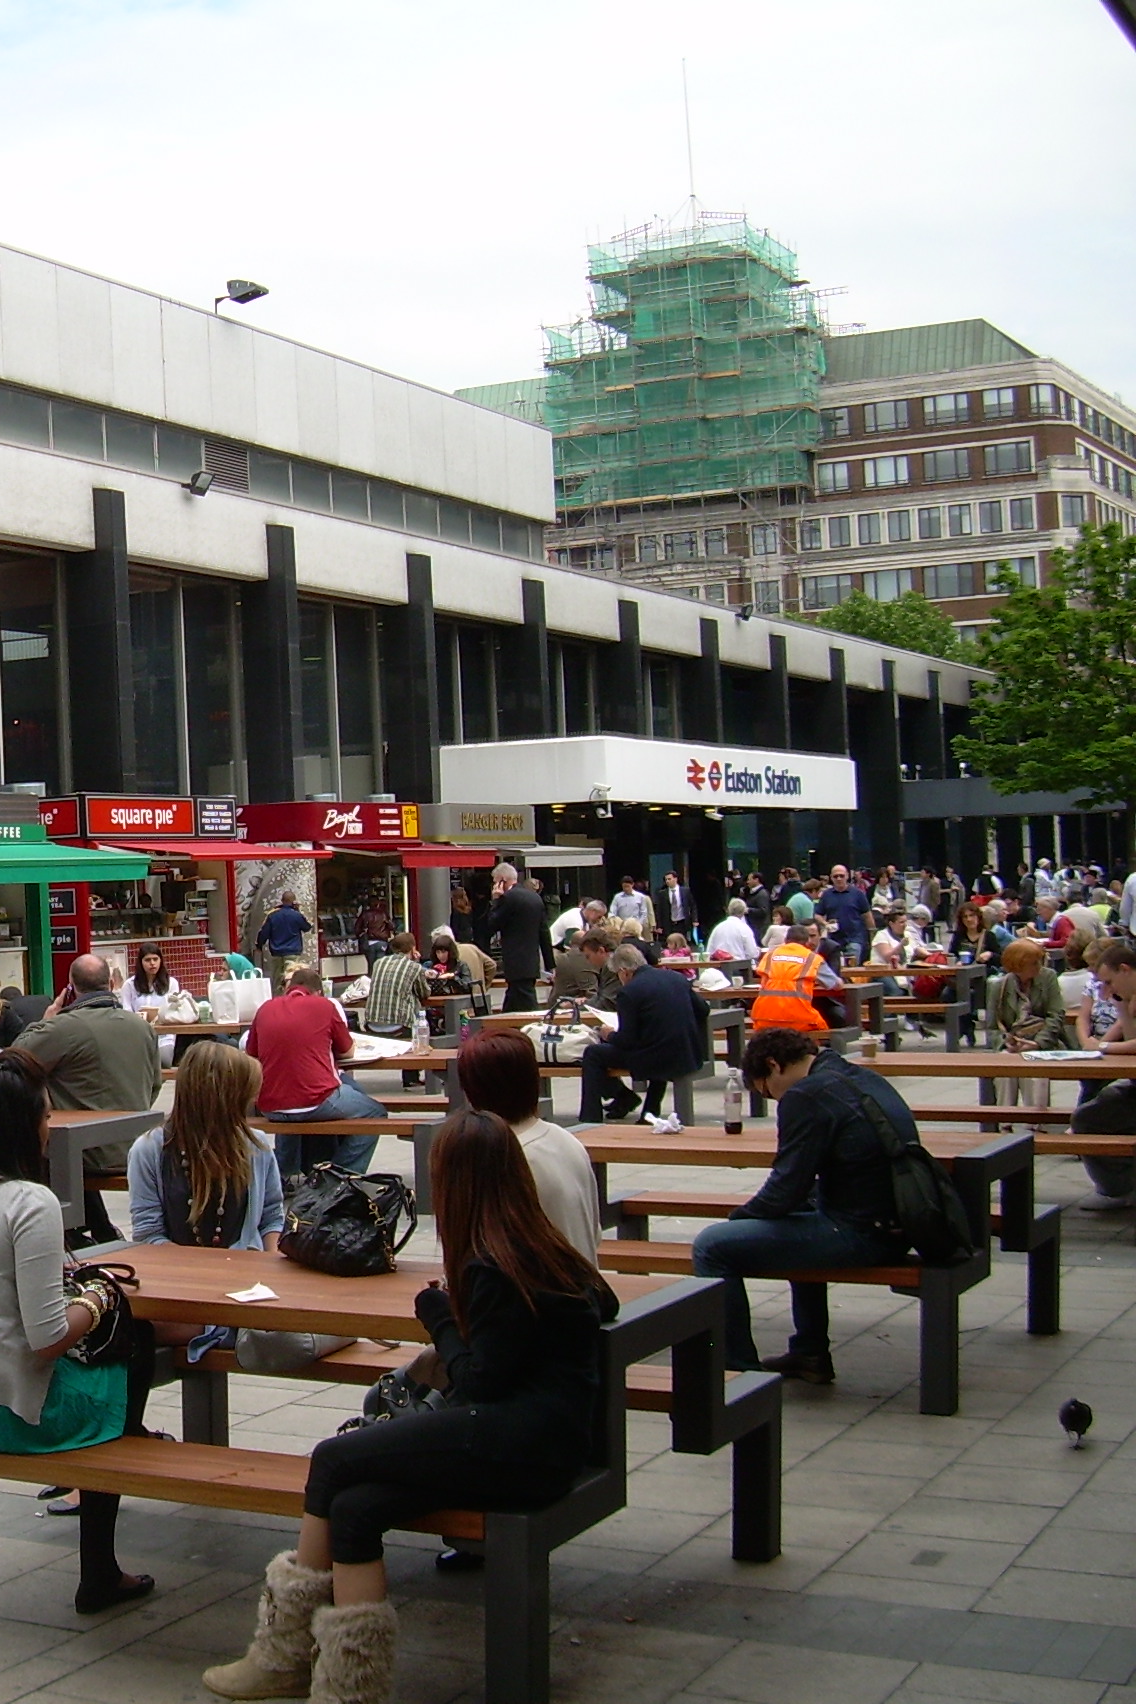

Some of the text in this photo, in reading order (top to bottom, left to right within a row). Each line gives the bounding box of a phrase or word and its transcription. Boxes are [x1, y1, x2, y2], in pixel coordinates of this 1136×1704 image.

[724, 762, 802, 796] Euston Station
[39, 811, 54, 825] ie
[110, 808, 153, 830] square
[322, 804, 363, 839] Bagel
